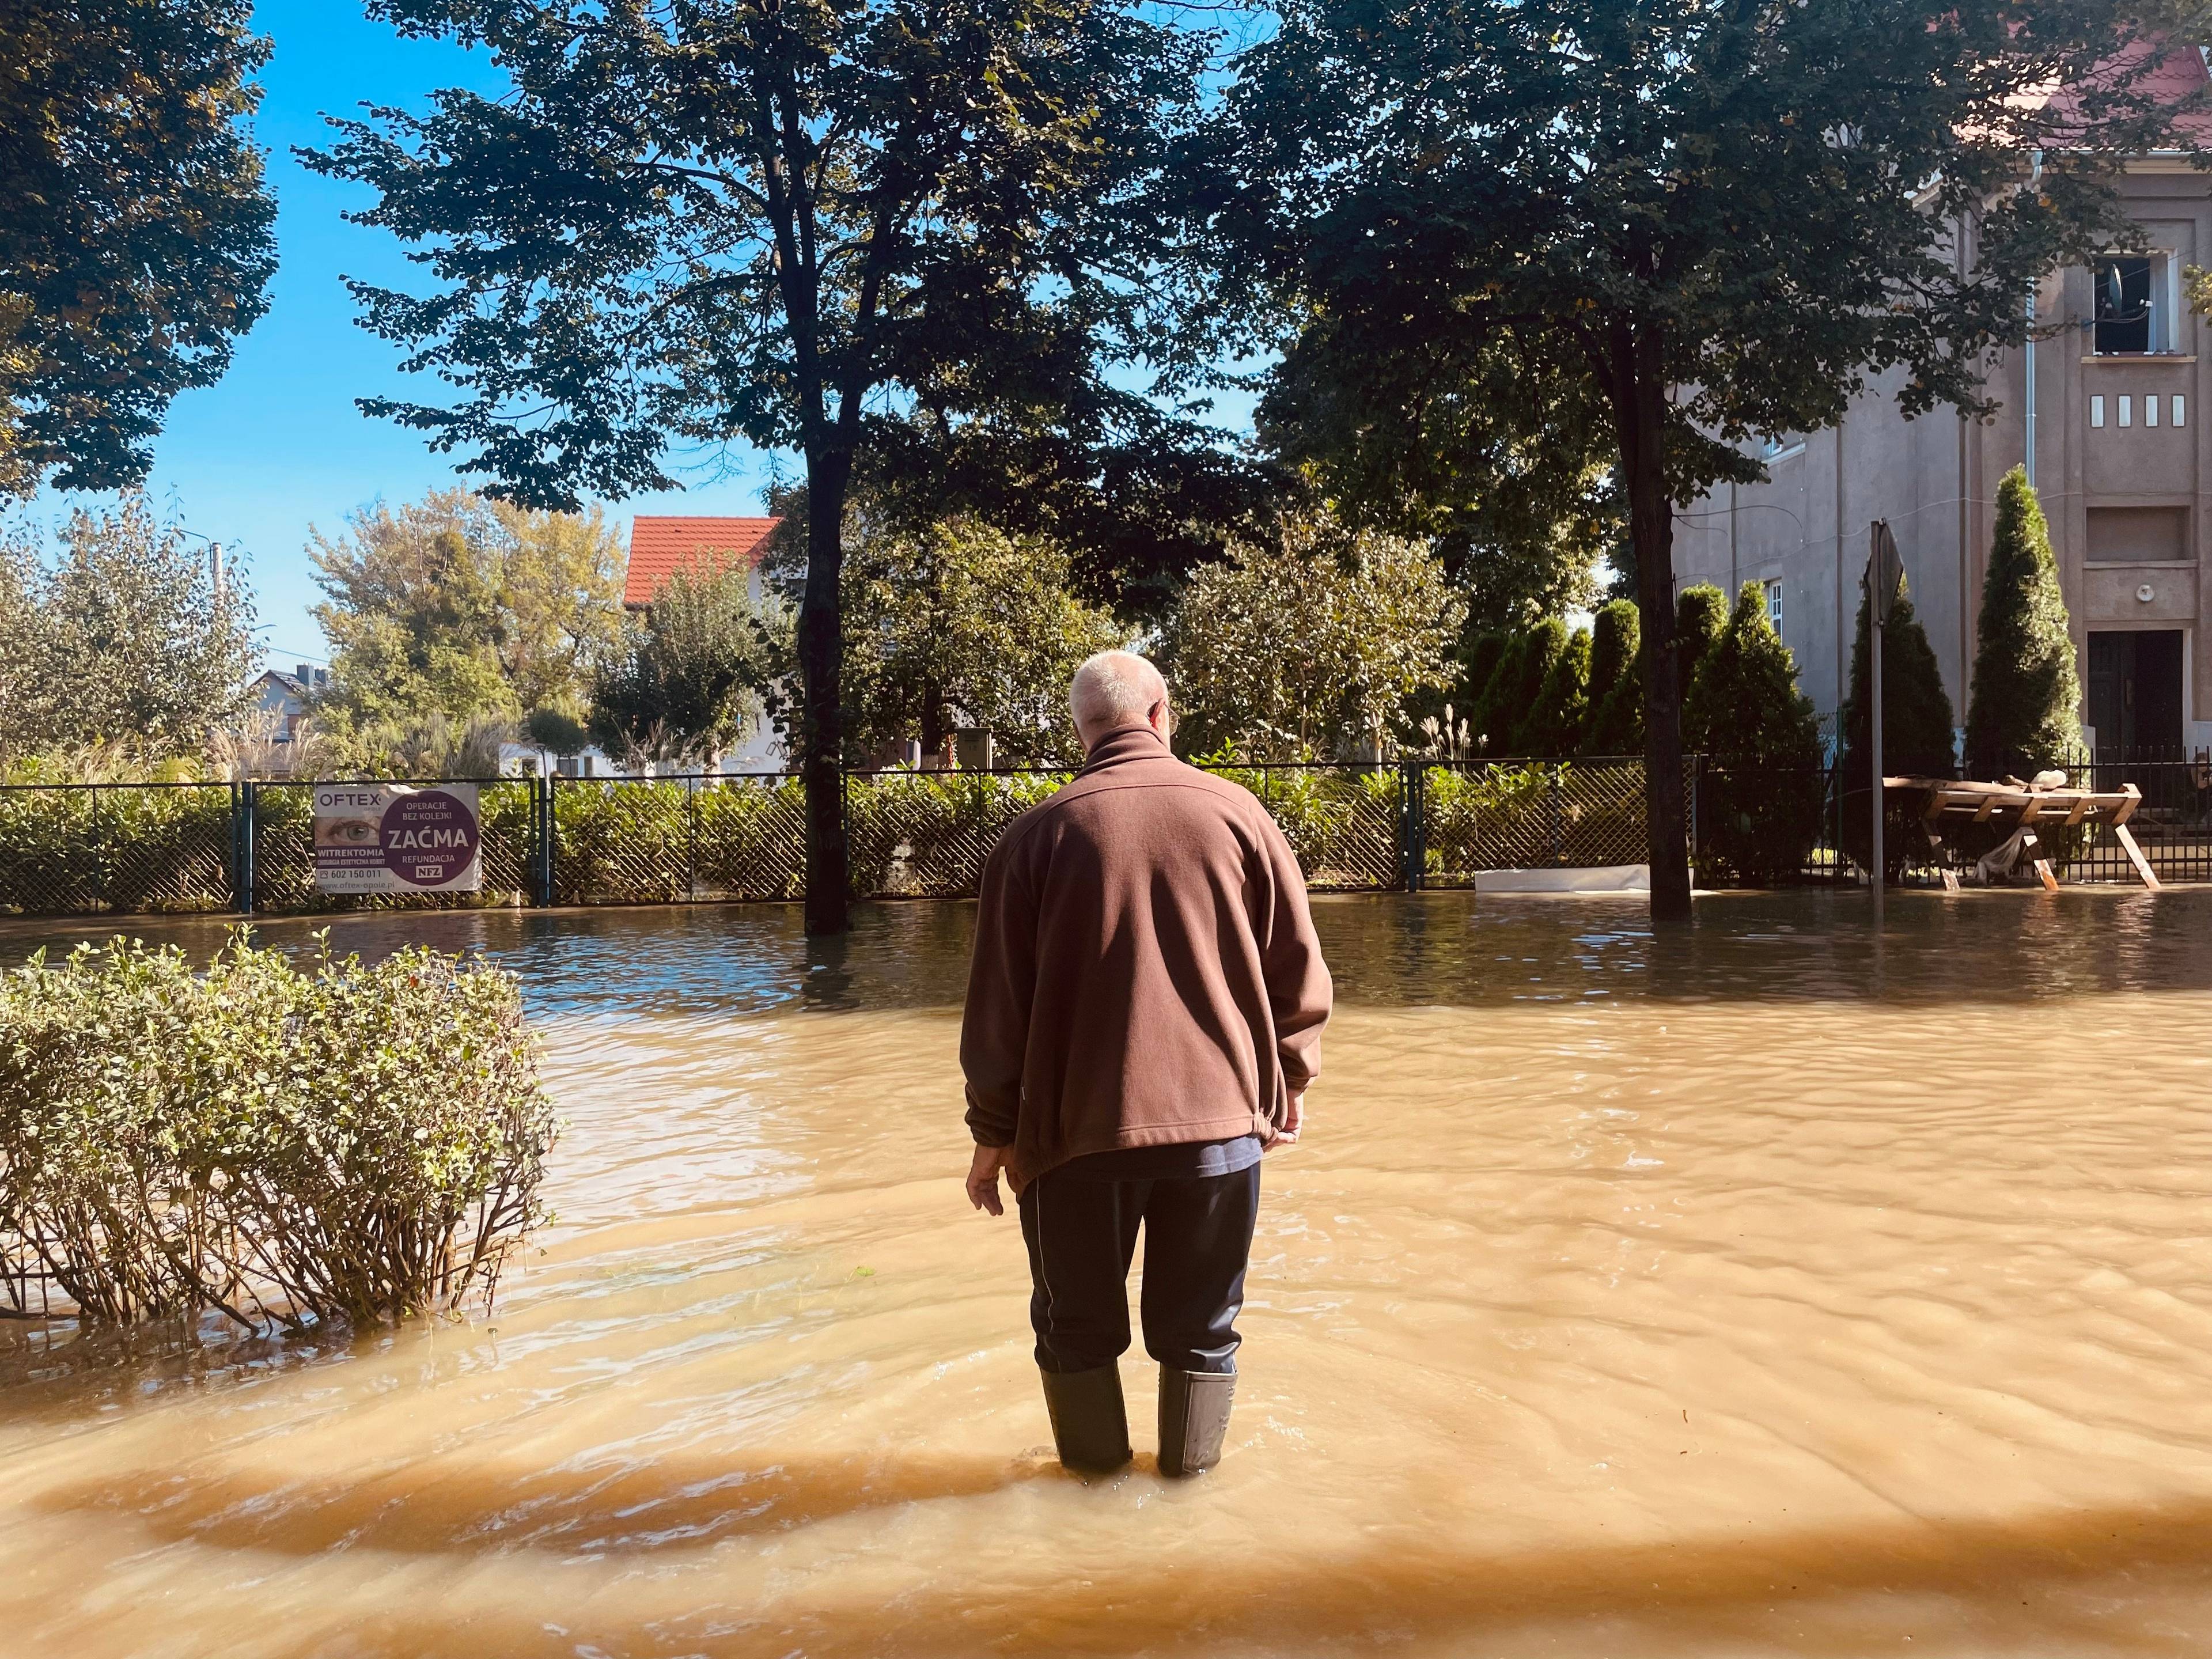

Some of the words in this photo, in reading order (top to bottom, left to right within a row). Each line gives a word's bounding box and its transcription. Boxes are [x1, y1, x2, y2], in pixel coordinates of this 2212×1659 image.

[320, 794, 380, 806] OFTEX
[406, 802, 447, 810] OPERACJE
[419, 812, 452, 820] KOLEJKI
[388, 825, 469, 849] ZAĆMA
[402, 855, 455, 863] REFUNDACJA
[418, 868, 440, 876] NFZ
